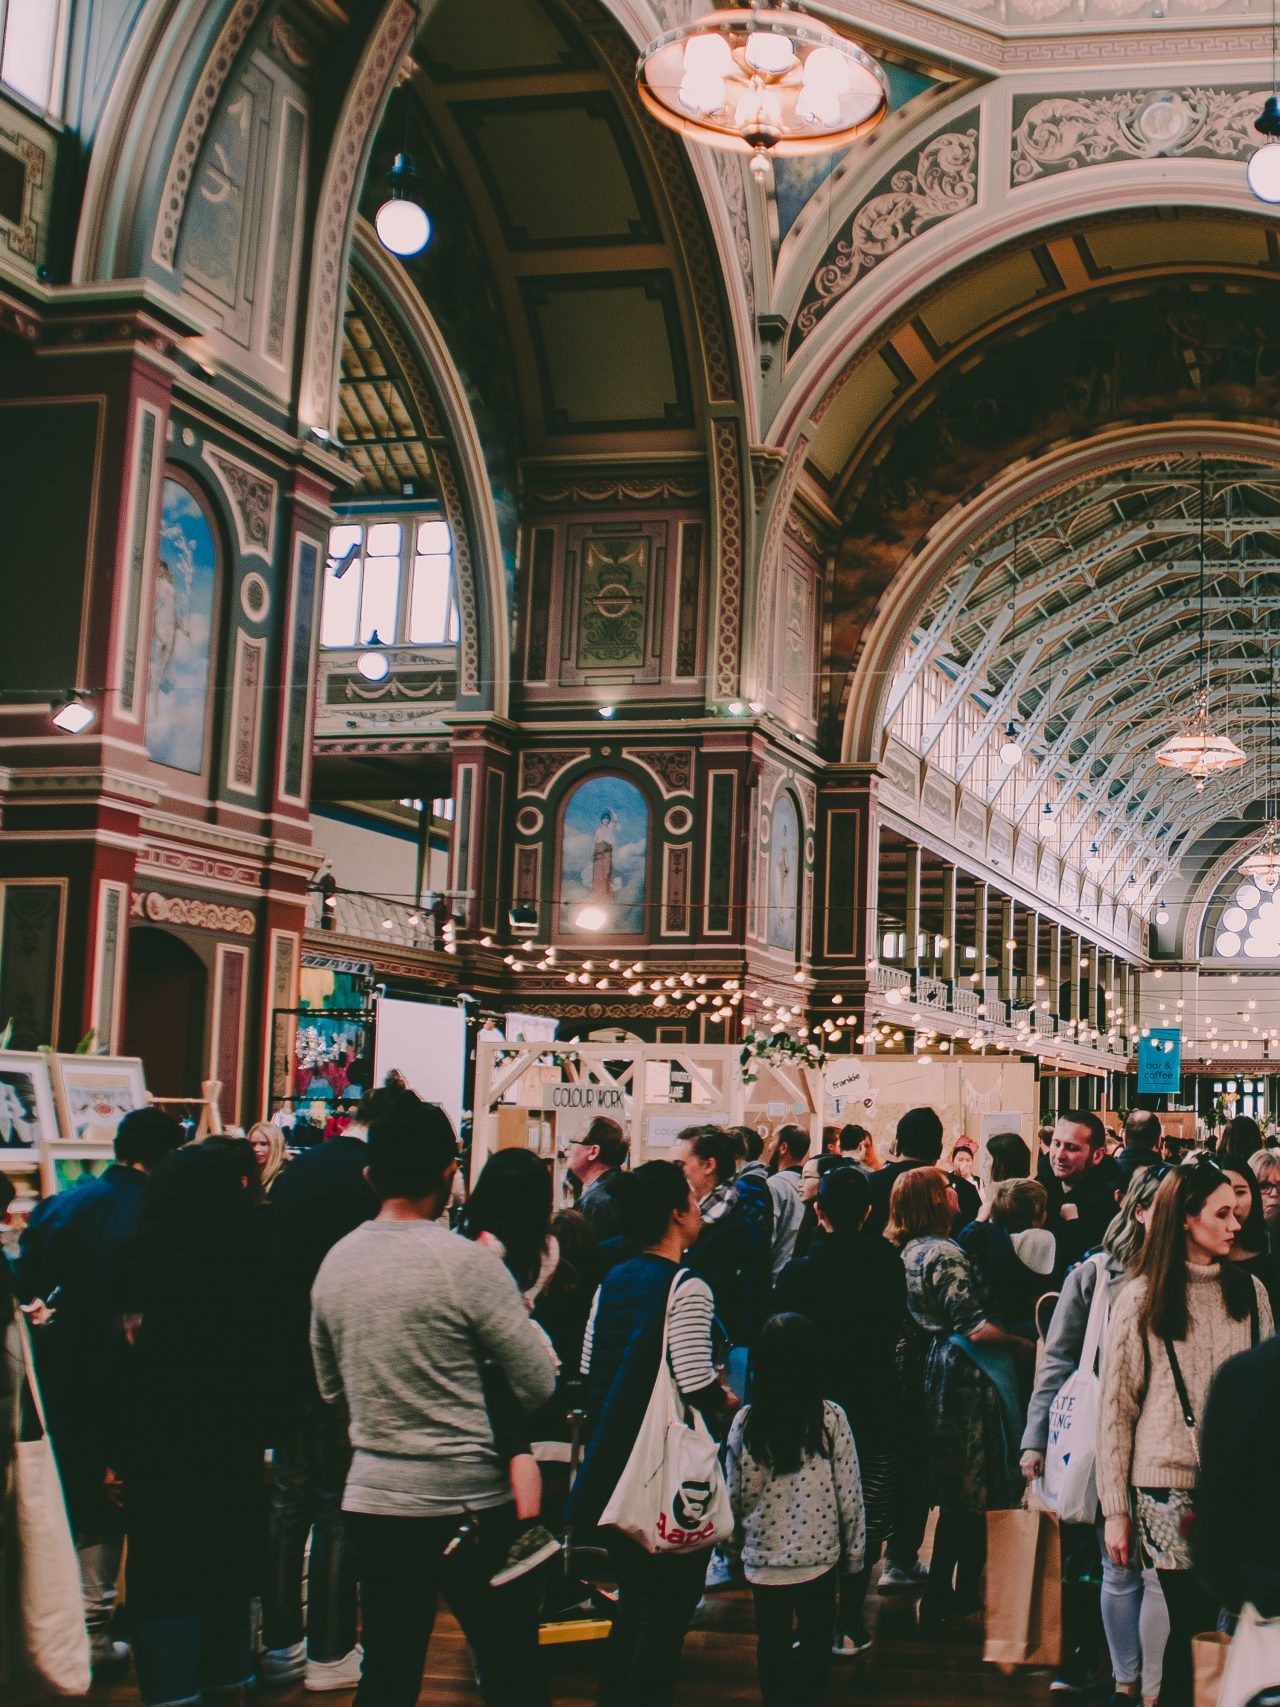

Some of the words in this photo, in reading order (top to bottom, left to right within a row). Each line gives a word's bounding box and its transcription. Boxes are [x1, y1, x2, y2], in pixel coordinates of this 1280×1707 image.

[1146, 1061, 1162, 1070] bar
[1164, 1061, 1172, 1070] &
[832, 1073, 861, 1089] frankie
[1144, 1071, 1174, 1080] coffee
[552, 1087, 595, 1108] COLOUR
[596, 1089, 624, 1109] WORK
